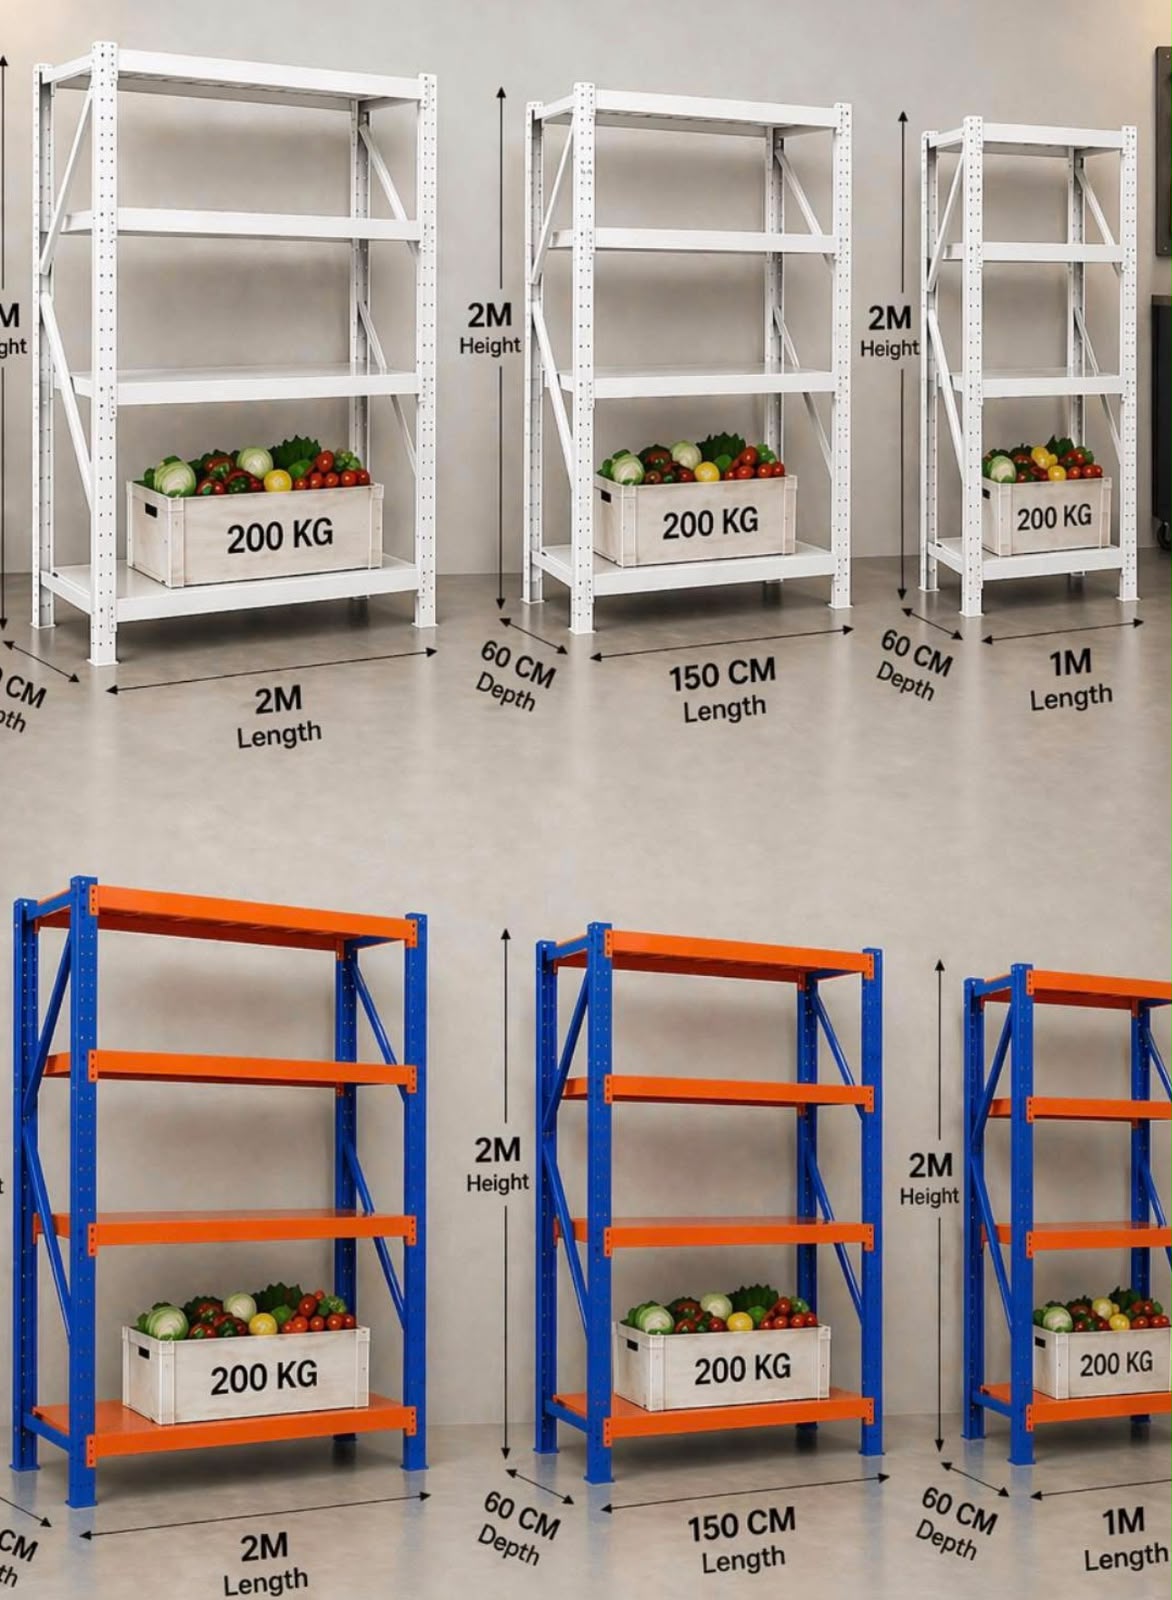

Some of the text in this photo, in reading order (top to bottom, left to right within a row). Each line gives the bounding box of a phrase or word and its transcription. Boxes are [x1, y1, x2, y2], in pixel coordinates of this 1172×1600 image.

[663, 506, 758, 540] 200 KG
[1017, 503, 1091, 531] 200 KG
[228, 517, 333, 554] 200 KG
[211, 1360, 317, 1395] 200 KG
[695, 1353, 791, 1385] 200 KG
[1080, 1350, 1152, 1377] 200 KG
